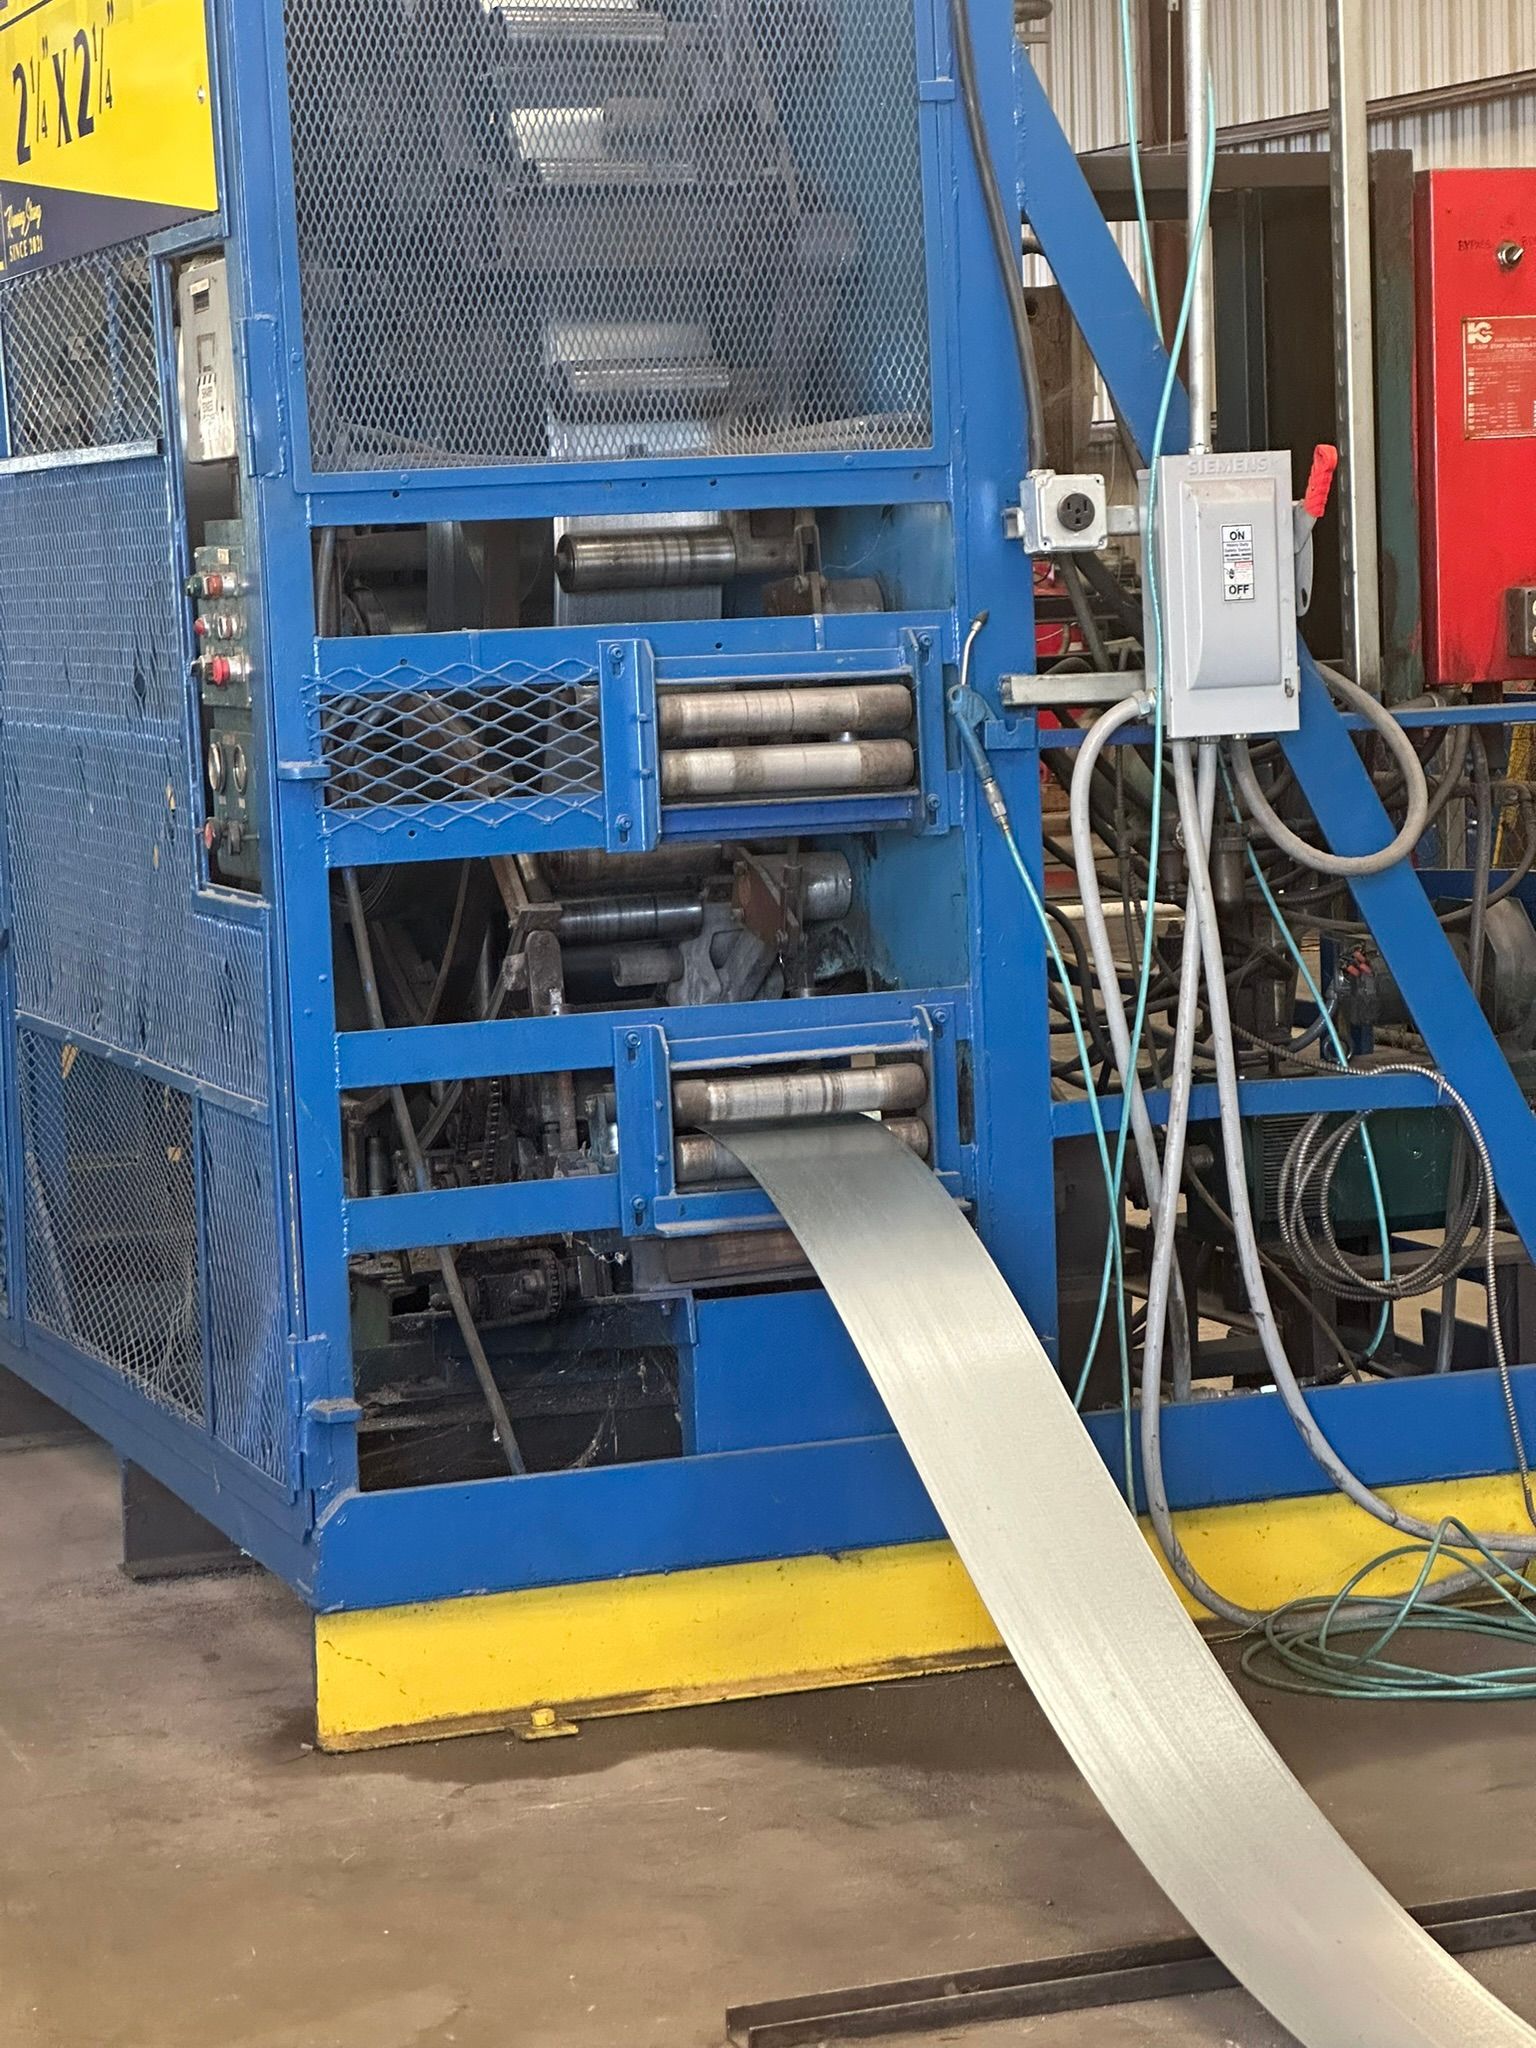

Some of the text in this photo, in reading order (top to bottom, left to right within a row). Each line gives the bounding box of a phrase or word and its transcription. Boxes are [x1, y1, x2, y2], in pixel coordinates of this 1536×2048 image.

[1187, 456, 1268, 475] SIEMENS
[1229, 531, 1245, 541] ON
[1229, 584, 1250, 595] OFF
